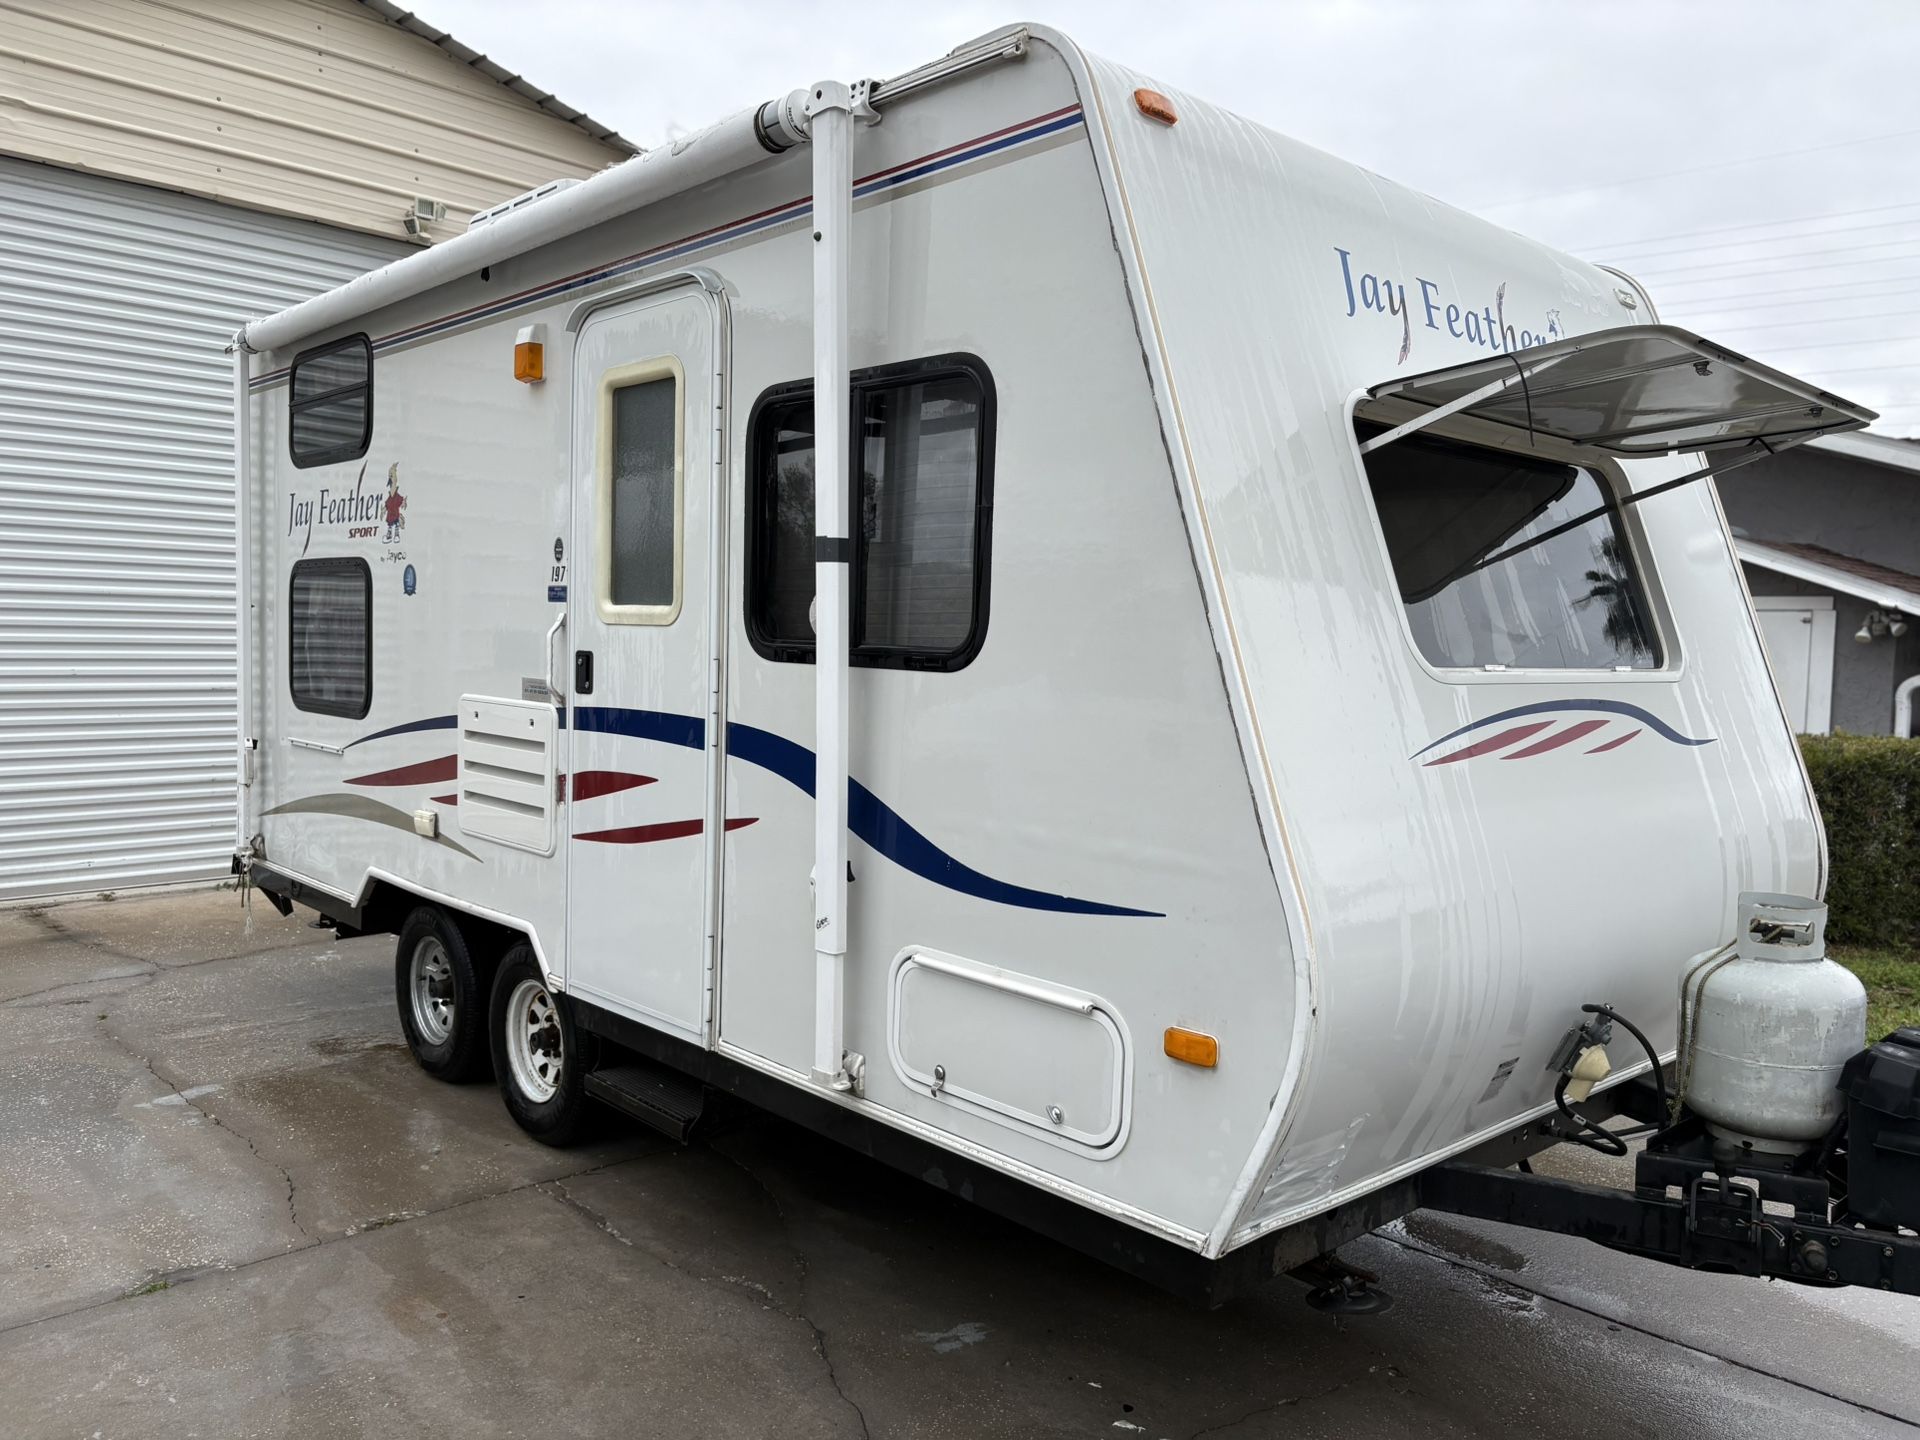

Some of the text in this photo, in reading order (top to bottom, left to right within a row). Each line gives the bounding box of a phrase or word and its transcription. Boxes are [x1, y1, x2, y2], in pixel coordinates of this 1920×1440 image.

[1333, 246, 1412, 366] Jay
[288, 460, 383, 557] Jay Feather
[348, 526, 379, 539] SPORT
[551, 565, 566, 583] 197
